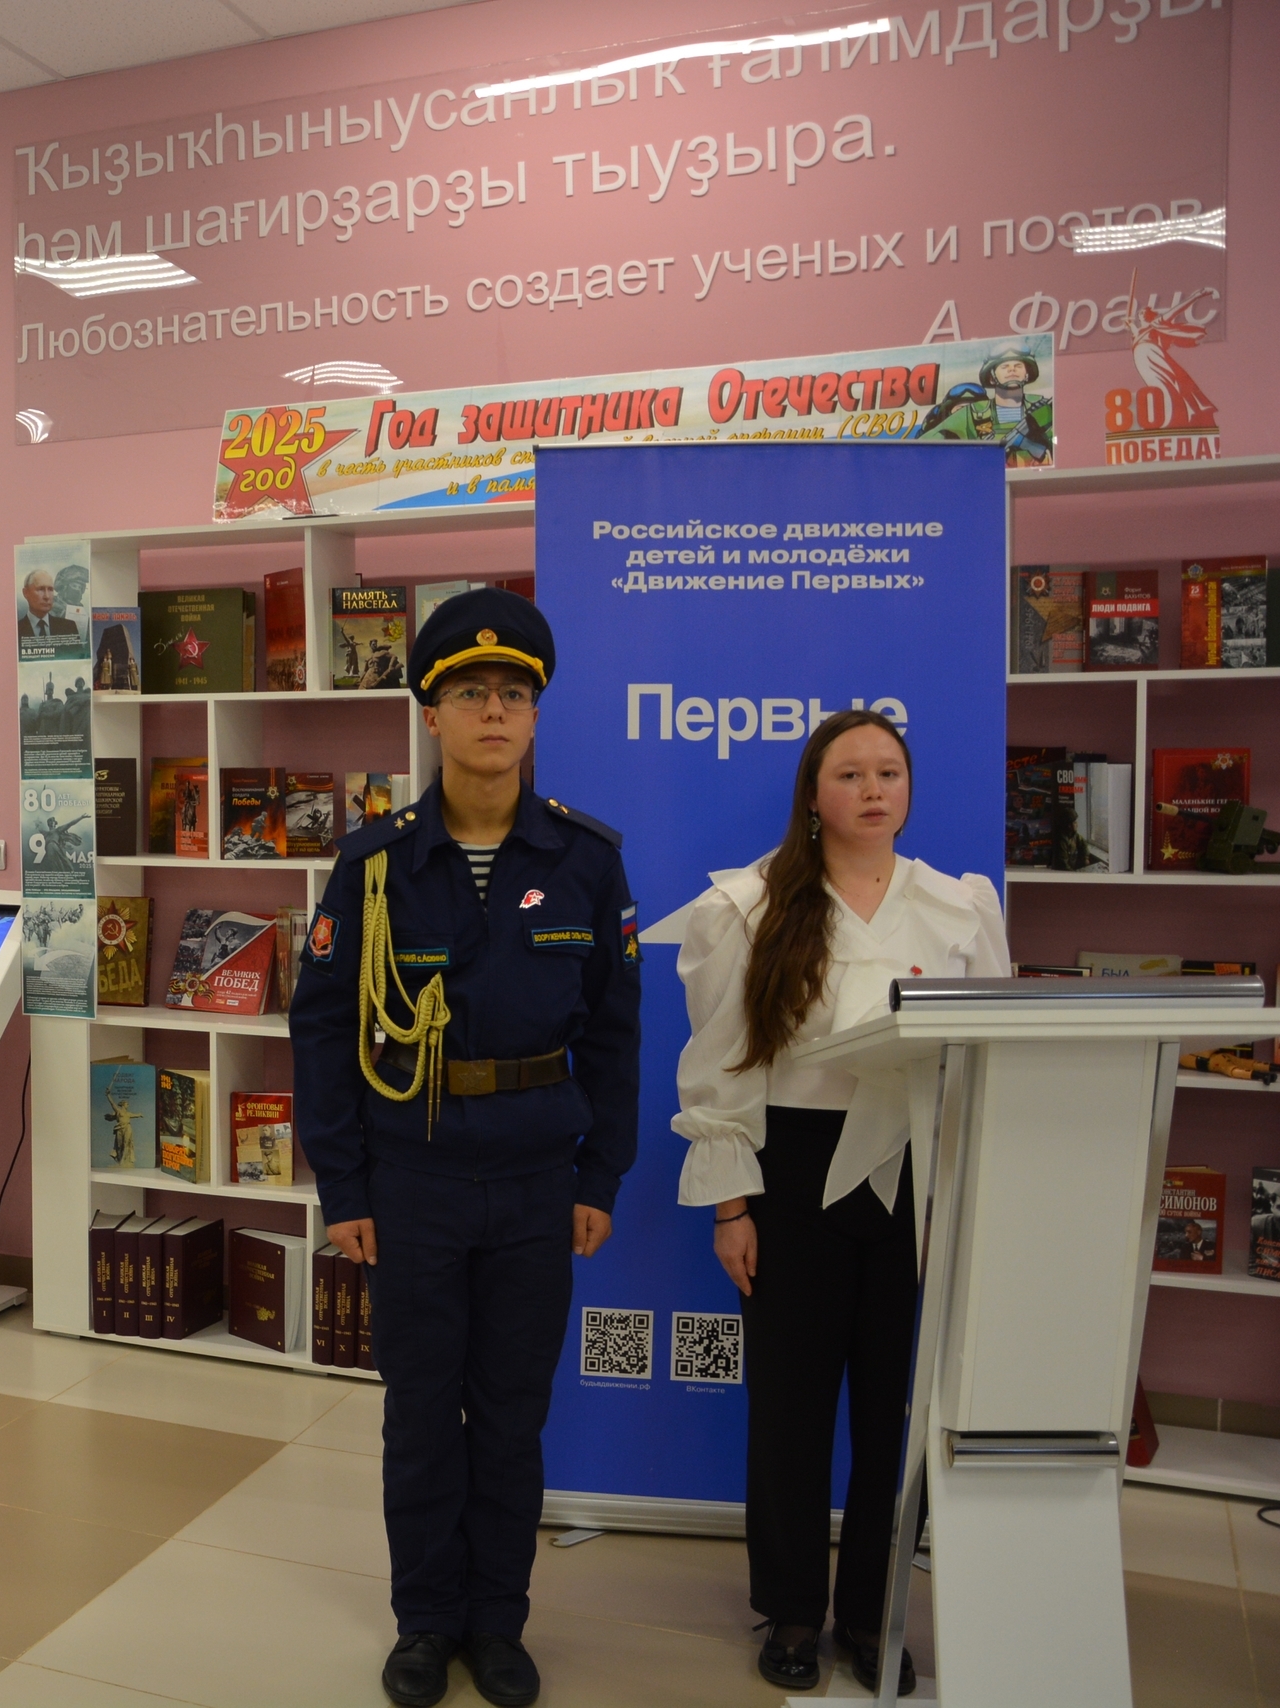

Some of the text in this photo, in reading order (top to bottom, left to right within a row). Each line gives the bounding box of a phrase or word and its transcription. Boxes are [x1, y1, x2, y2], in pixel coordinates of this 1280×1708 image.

[17, 282, 450, 364] Любознательность
[465, 257, 675, 313] создает
[691, 231, 905, 301] ученых
[925, 225, 959, 264] и
[920, 299, 979, 345] А
[224, 362, 941, 459] 2025 Год защитника Отечества
[1105, 386, 1166, 432] 80
[316, 457, 329, 478] в
[334, 458, 388, 478] честь
[392, 446, 505, 480] участников
[836, 409, 919, 441] (СВО)
[1105, 436, 1220, 466] ПОБЕДА!
[238, 454, 298, 494] год
[446, 480, 460, 496] и
[466, 473, 482, 495] в
[592, 519, 944, 542] Российское движение
[625, 544, 910, 567] детей и молодёжи
[611, 570, 925, 594] «Движение Первых»
[342, 590, 389, 602] ПАМЯТЬ
[342, 600, 398, 610] НАВСЕГДА
[1091, 602, 1152, 614] ЛЮДИ ПОДВИГА
[23, 788, 57, 812] 80
[232, 797, 262, 807] Победы
[1172, 798, 1215, 806] МАЛЕНЬКИЕ
[28, 833, 47, 864] 9
[65, 850, 95, 864] МАЯ
[98, 957, 143, 994] БЕДА
[213, 976, 260, 992] ПОБЕД
[221, 969, 261, 980] ВЕЛИКИХ
[246, 1102, 285, 1112] ФРОНТОВЫЕ
[246, 1109, 280, 1119] РЕЛИКВИИ
[1158, 1195, 1218, 1212] СИМОНОВ
[1160, 1188, 1197, 1197] ОНСТАНТИН
[686, 1385, 726, 1394] ВКонтакте
